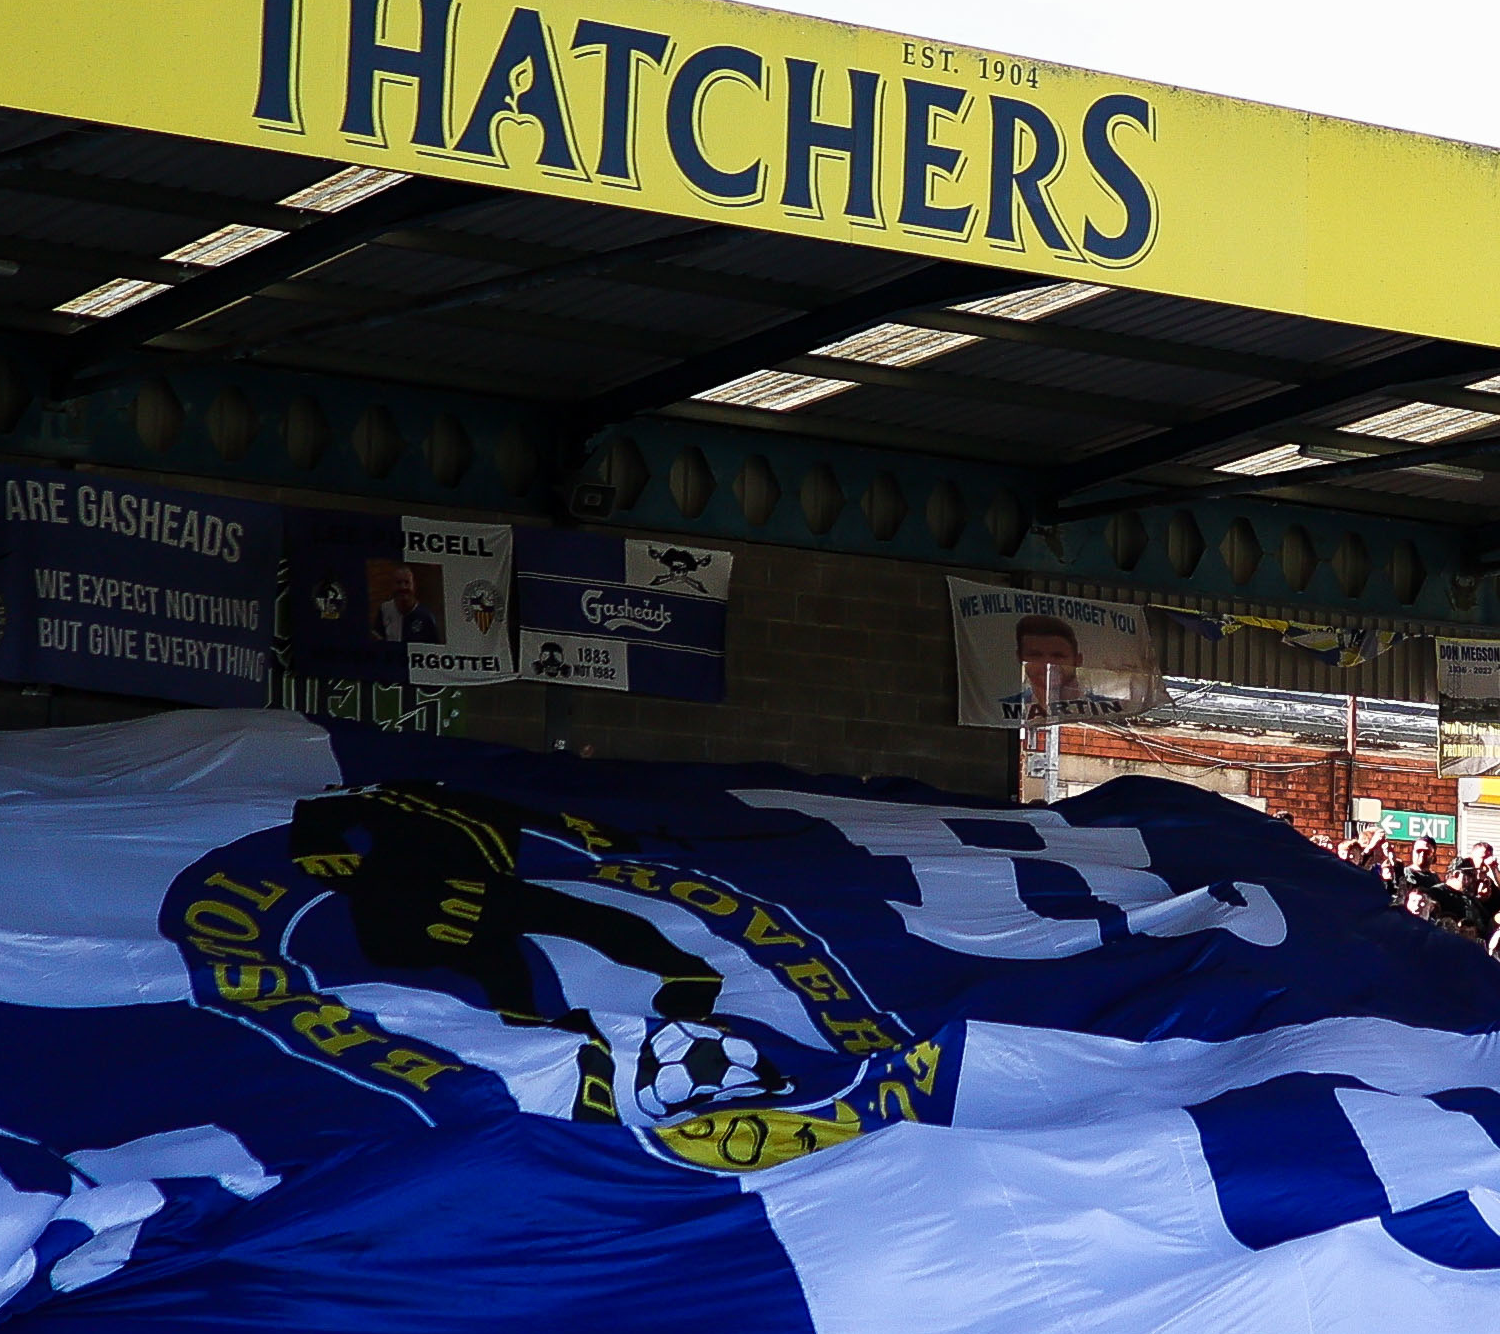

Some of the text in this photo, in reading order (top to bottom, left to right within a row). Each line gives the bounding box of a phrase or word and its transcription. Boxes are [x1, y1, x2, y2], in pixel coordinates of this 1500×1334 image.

[901, 41, 1040, 90] EST. 1904
[4, 479, 71, 525] ARE
[77, 484, 244, 564] GASHEADS
[397, 532, 494, 557] RCELL
[34, 568, 260, 631] WE EXPECT NOTHING
[580, 589, 672, 624] Gasheads
[959, 594, 1136, 636] WE WILL NEVER FORGET YOU
[37, 617, 266, 683] BUT GIVE EVERYTHING
[411, 653, 500, 671] RGOTTE
[578, 648, 611, 665] 1883
[1440, 645, 1500, 662] DON MEGSON
[573, 664, 616, 680] NOT 1982
[1001, 700, 1122, 719] MARTIN
[1408, 815, 1450, 838] EXIT
